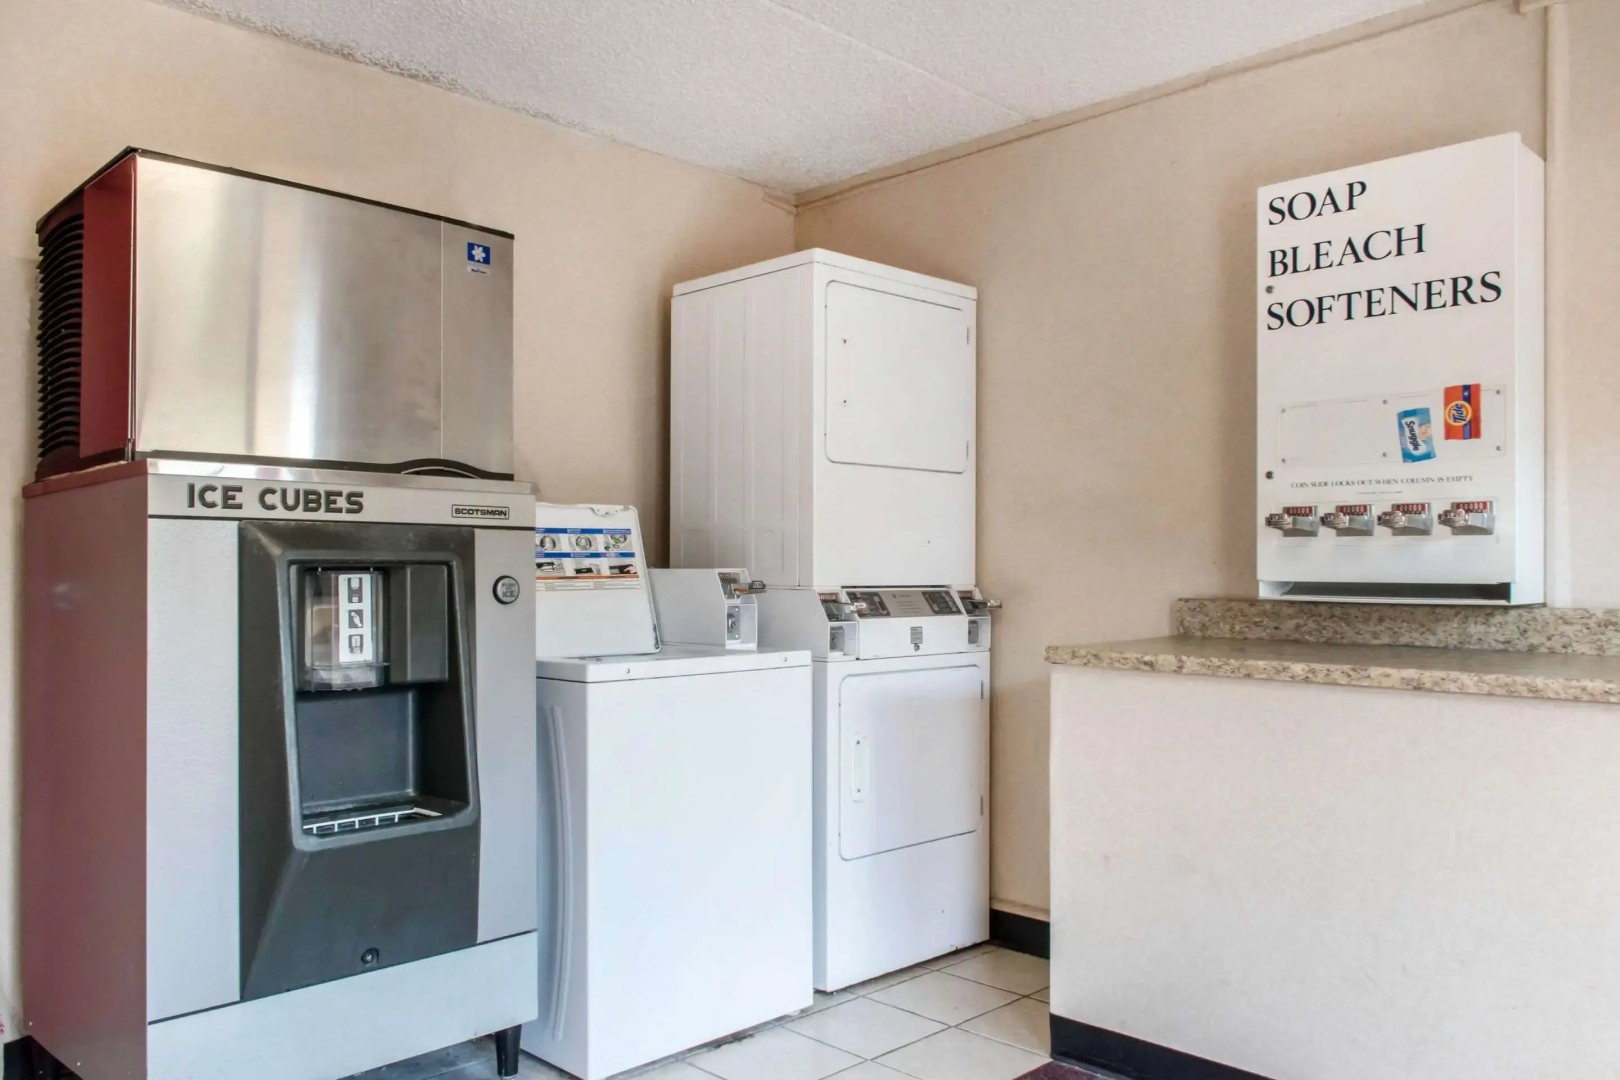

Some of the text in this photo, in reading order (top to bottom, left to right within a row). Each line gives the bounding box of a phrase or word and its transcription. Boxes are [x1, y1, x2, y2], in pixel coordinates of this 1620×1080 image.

[1268, 180, 1367, 226] SOAP
[1268, 223, 1426, 278] BLEACH
[1266, 271, 1502, 331] SOFTENERS
[1452, 403, 1466, 423] Tide
[1404, 420, 1421, 452] Snuggle
[1446, 475, 1473, 483] EMPTY
[187, 483, 363, 514] ICE CUBES
[454, 507, 507, 516] SCOTSMAN
[502, 590, 515, 598] ICE
